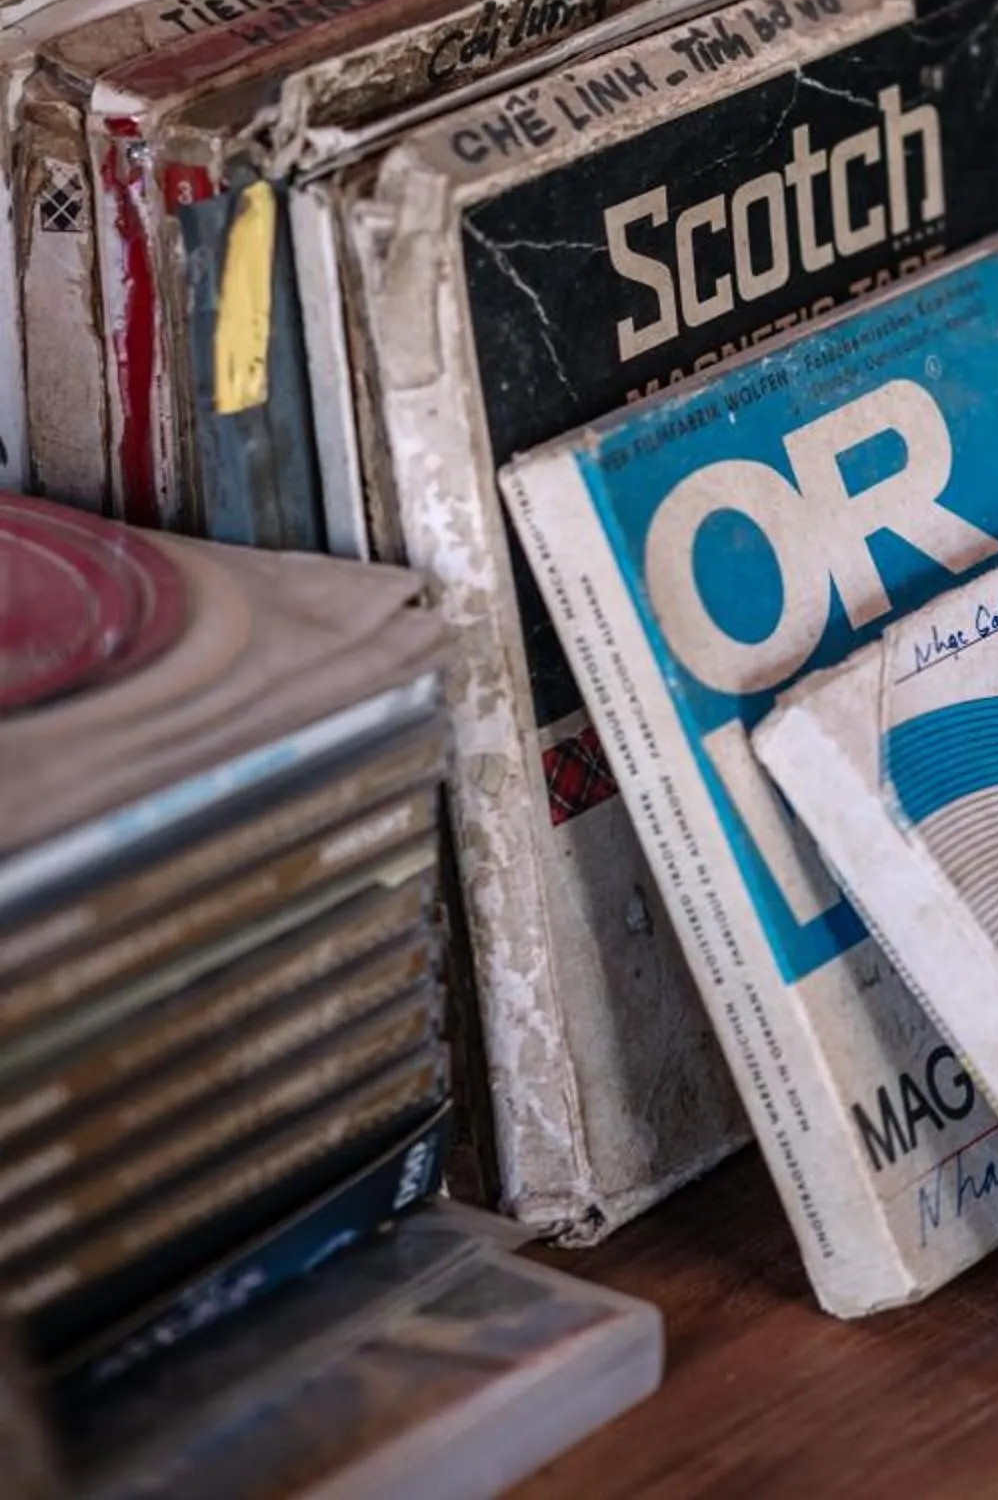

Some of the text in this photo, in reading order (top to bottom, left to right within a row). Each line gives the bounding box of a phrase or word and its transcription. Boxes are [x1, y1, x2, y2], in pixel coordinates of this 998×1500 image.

[603, 83, 945, 363] Scotch
[724, 368, 790, 413] WOLFEN
[604, 707, 639, 777] MARQUE
[638, 791, 663, 836] MARK
[657, 838, 685, 889] TRADE
[743, 981, 783, 1060] GERMANY
[786, 1087, 811, 1132] MADE
[850, 1045, 975, 1171] MAG
